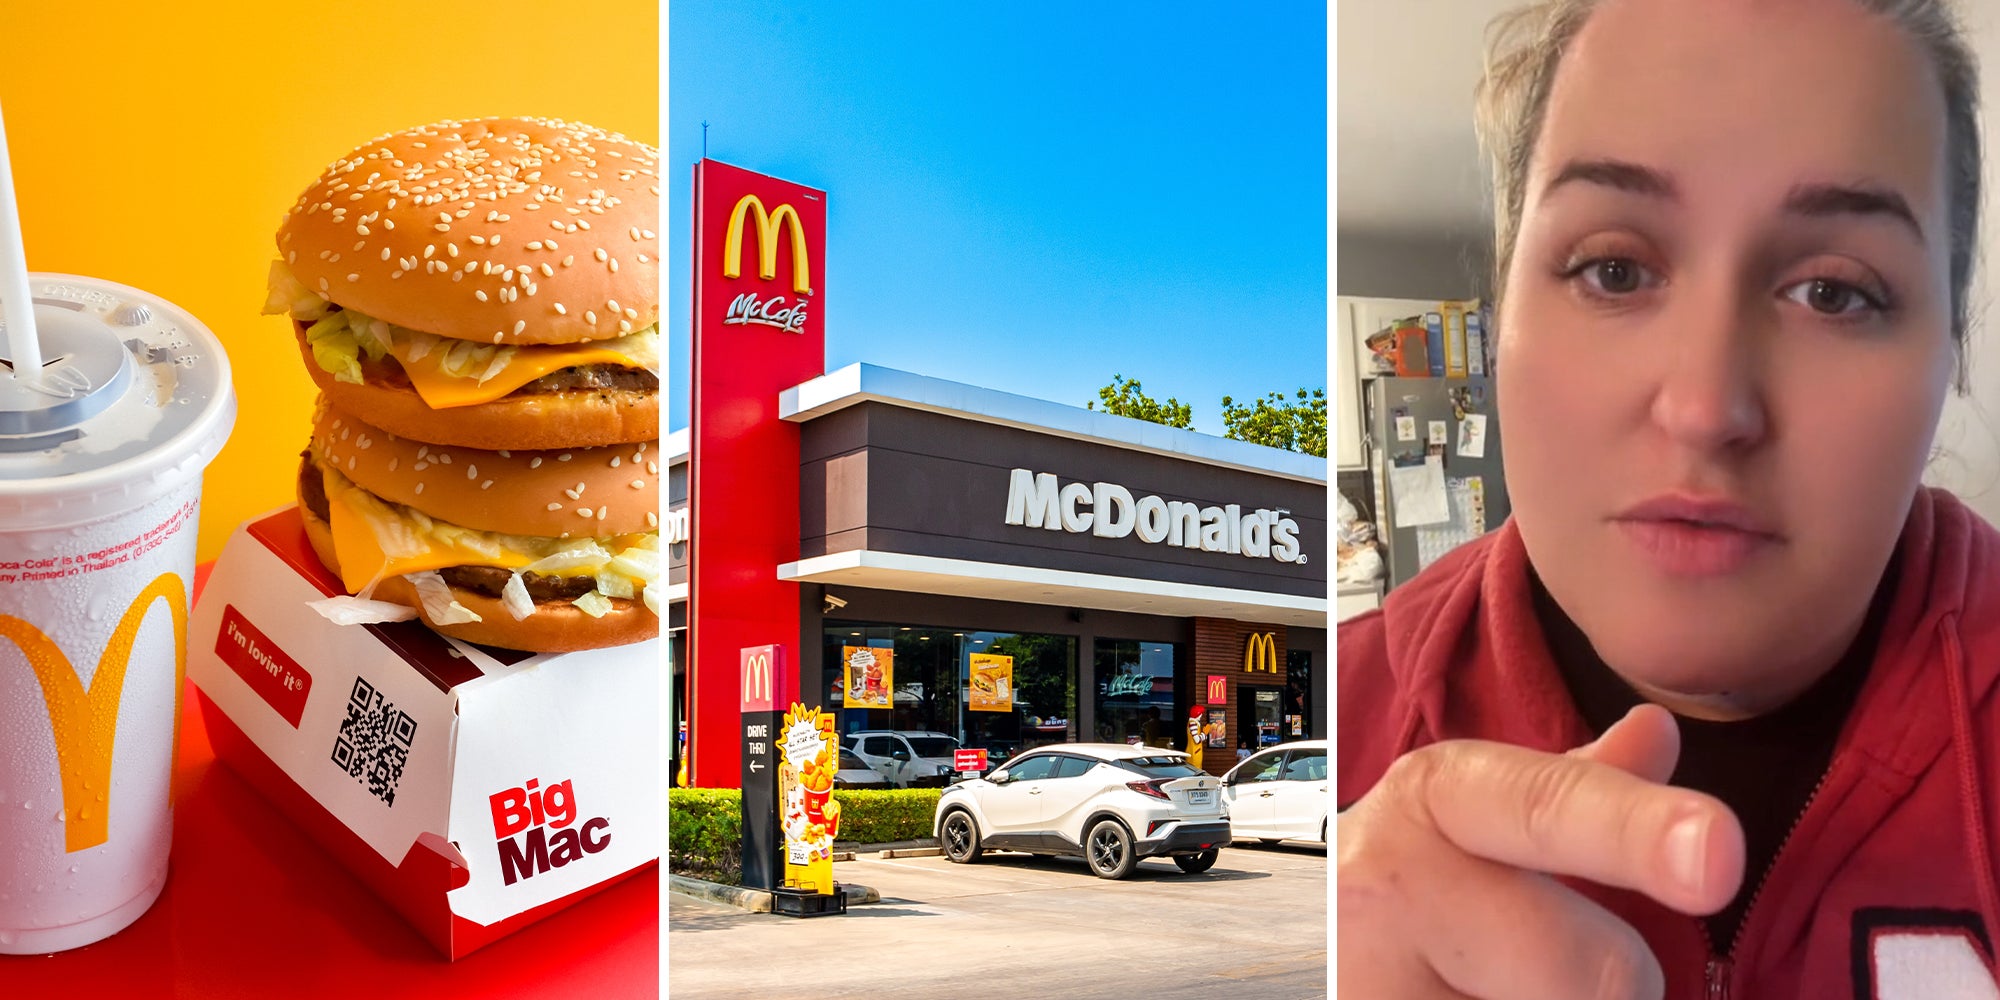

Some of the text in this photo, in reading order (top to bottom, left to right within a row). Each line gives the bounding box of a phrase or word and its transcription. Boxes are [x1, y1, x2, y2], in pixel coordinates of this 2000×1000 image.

[1005, 468, 1301, 563] McDonald's
[62, 556, 72, 565] is
[87, 535, 141, 559] registered
[22, 569, 65, 581] Printed
[227, 620, 247, 648] i'm
[248, 639, 283, 678] lovin'
[747, 724, 768, 738] DRIVE
[748, 742, 766, 755] THRU
[489, 777, 577, 840] Big
[497, 816, 612, 886] Mac
